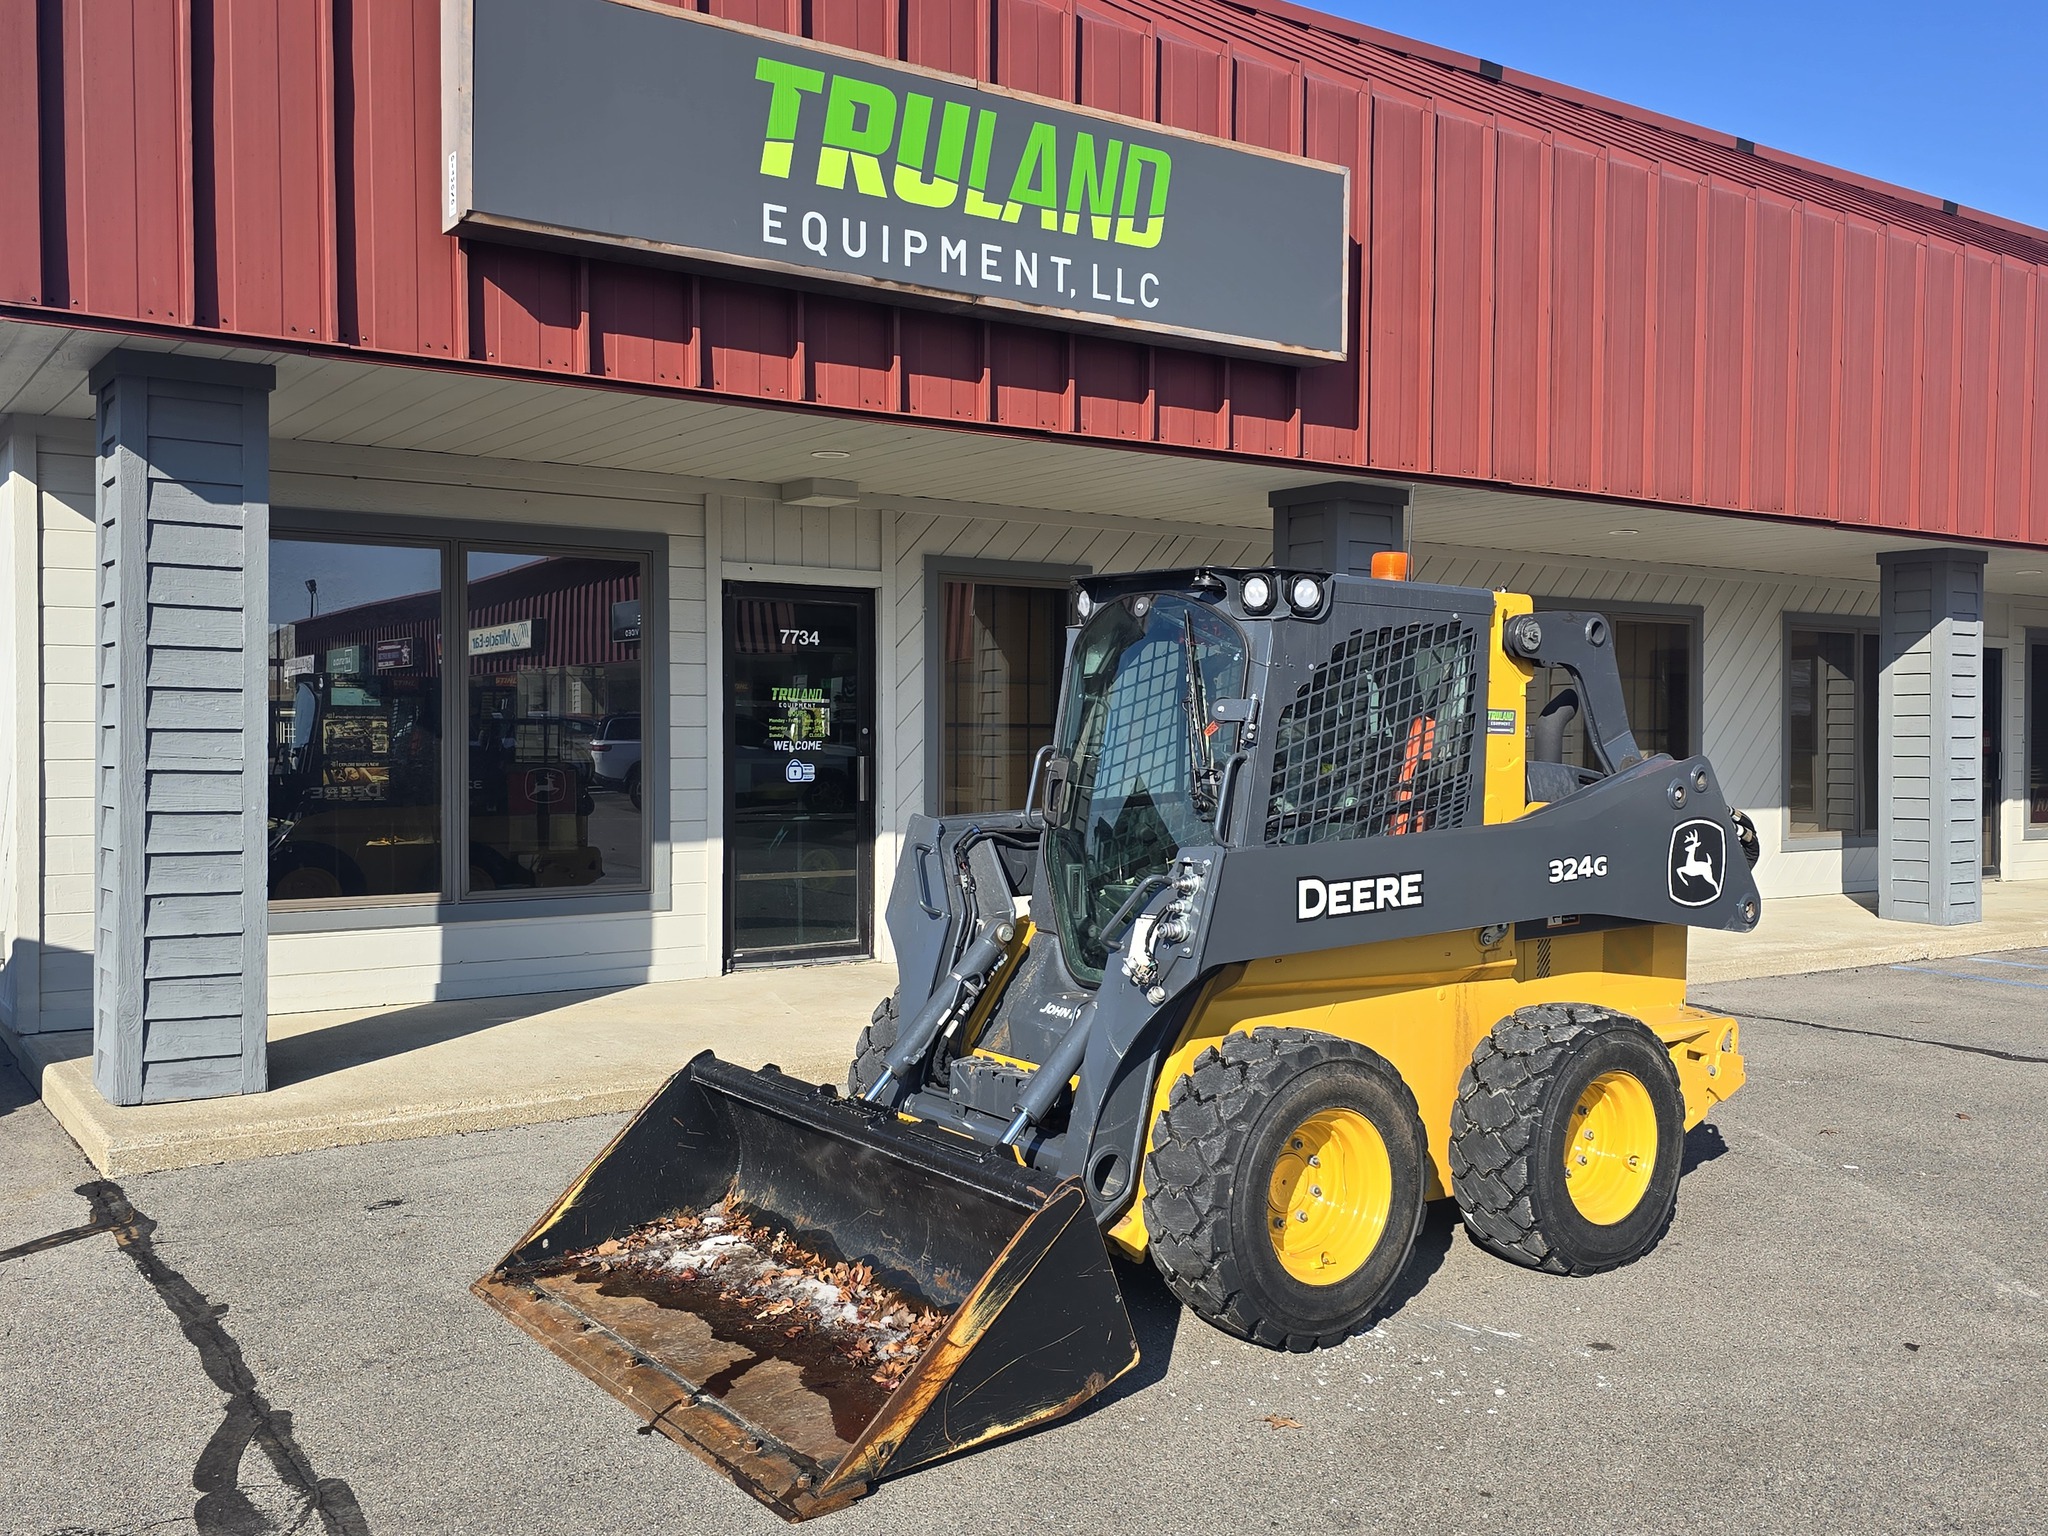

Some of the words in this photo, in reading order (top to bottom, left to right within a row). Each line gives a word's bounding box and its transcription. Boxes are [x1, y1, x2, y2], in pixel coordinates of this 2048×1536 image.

[755, 56, 1172, 249] TRULAND
[762, 202, 1077, 300] EQUIPMENT,
[1091, 263, 1161, 309] LLC
[779, 629, 820, 646] 7734
[771, 687, 823, 702] TRULAND
[1488, 711, 1514, 721] TRULAND
[773, 740, 823, 751] WELCOME
[1549, 855, 1608, 883] 324G
[1298, 873, 1423, 919] DEERE
[1039, 1002, 1071, 1018] JOHN
